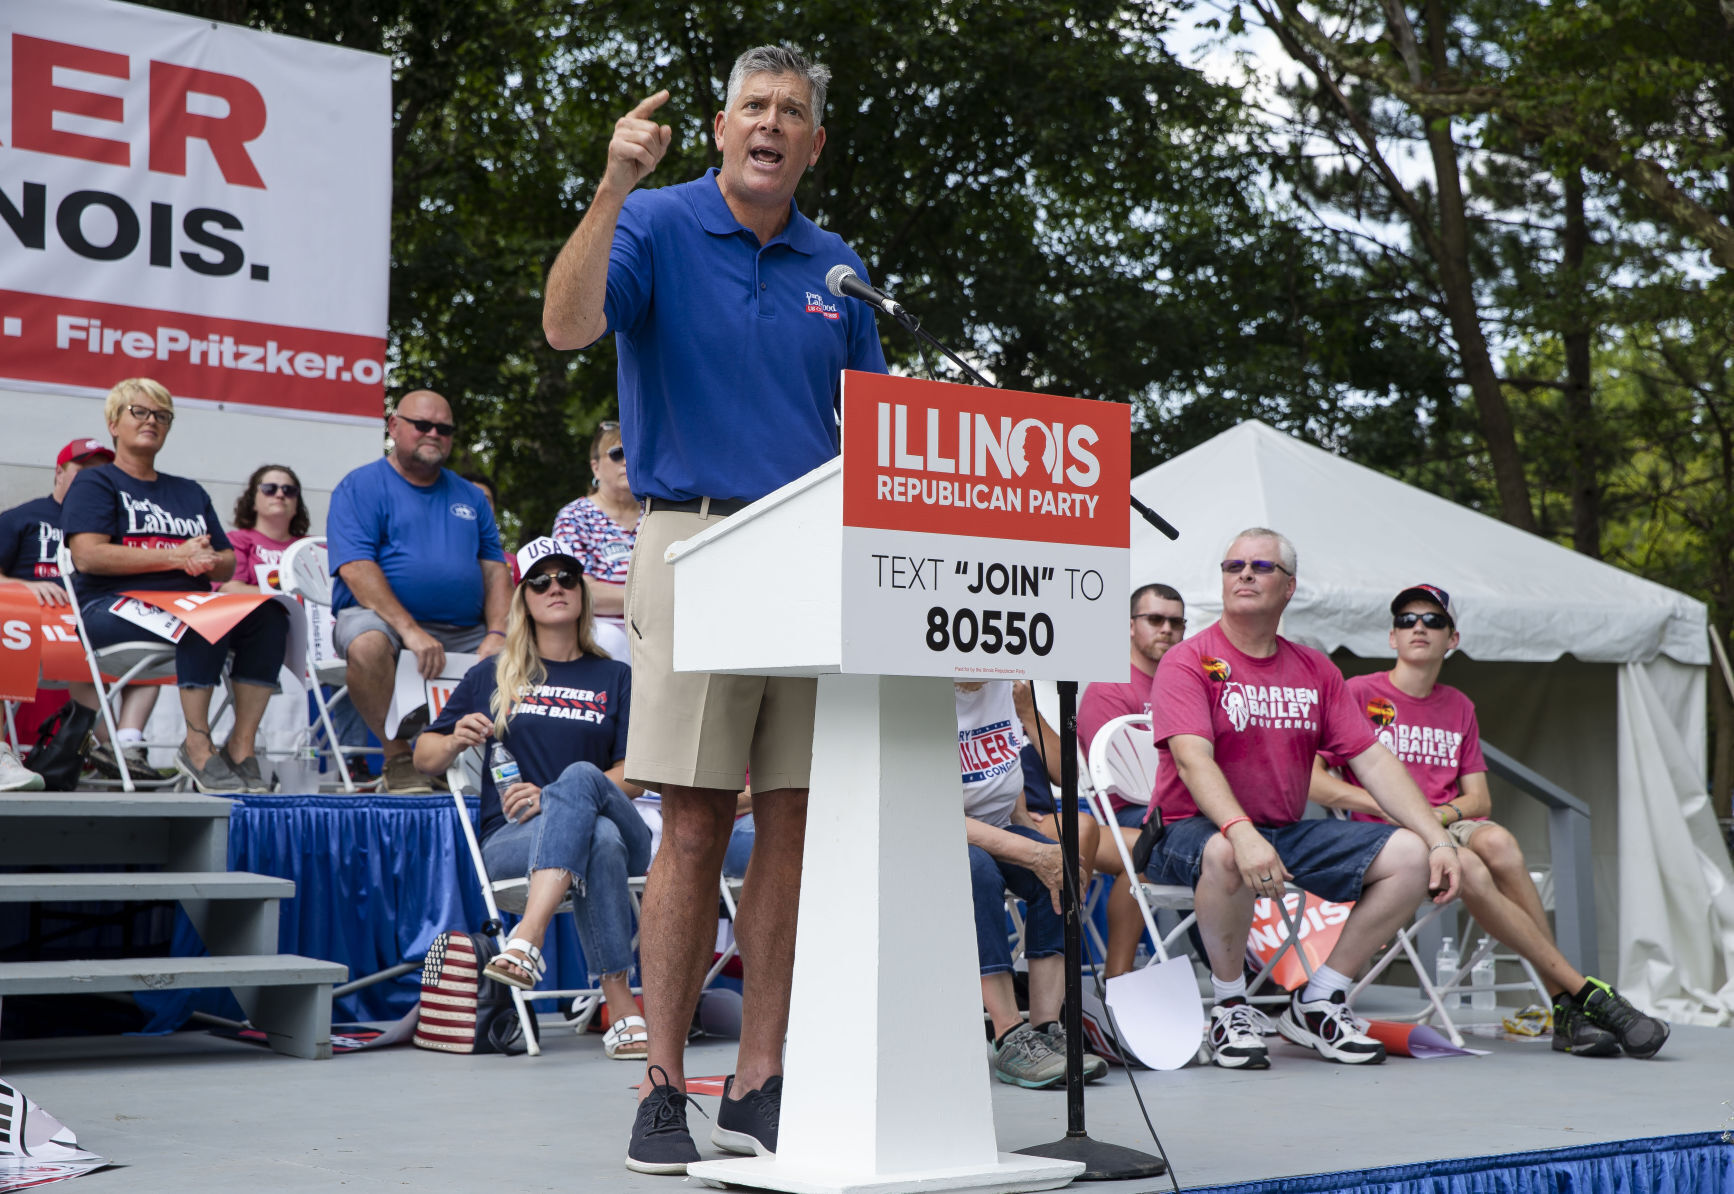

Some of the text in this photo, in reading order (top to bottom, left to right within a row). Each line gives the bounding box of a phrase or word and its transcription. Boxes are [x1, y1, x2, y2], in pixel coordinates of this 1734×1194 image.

[0, 32, 267, 190] ER
[877, 402, 1101, 488] ILLINOIS
[877, 475, 1099, 519] REPUBLICAN PARTY
[127, 508, 208, 538] LaHood
[527, 539, 564, 559] USA
[872, 554, 1104, 601] TEXT “JOIN” TO
[926, 606, 1055, 657] 80550
[1245, 684, 1319, 705] DARREN
[1248, 700, 1311, 719] BAILEY
[549, 705, 606, 725] BAILEY
[959, 733, 1017, 773] ILLER
[1398, 738, 1458, 759] BAILEY
